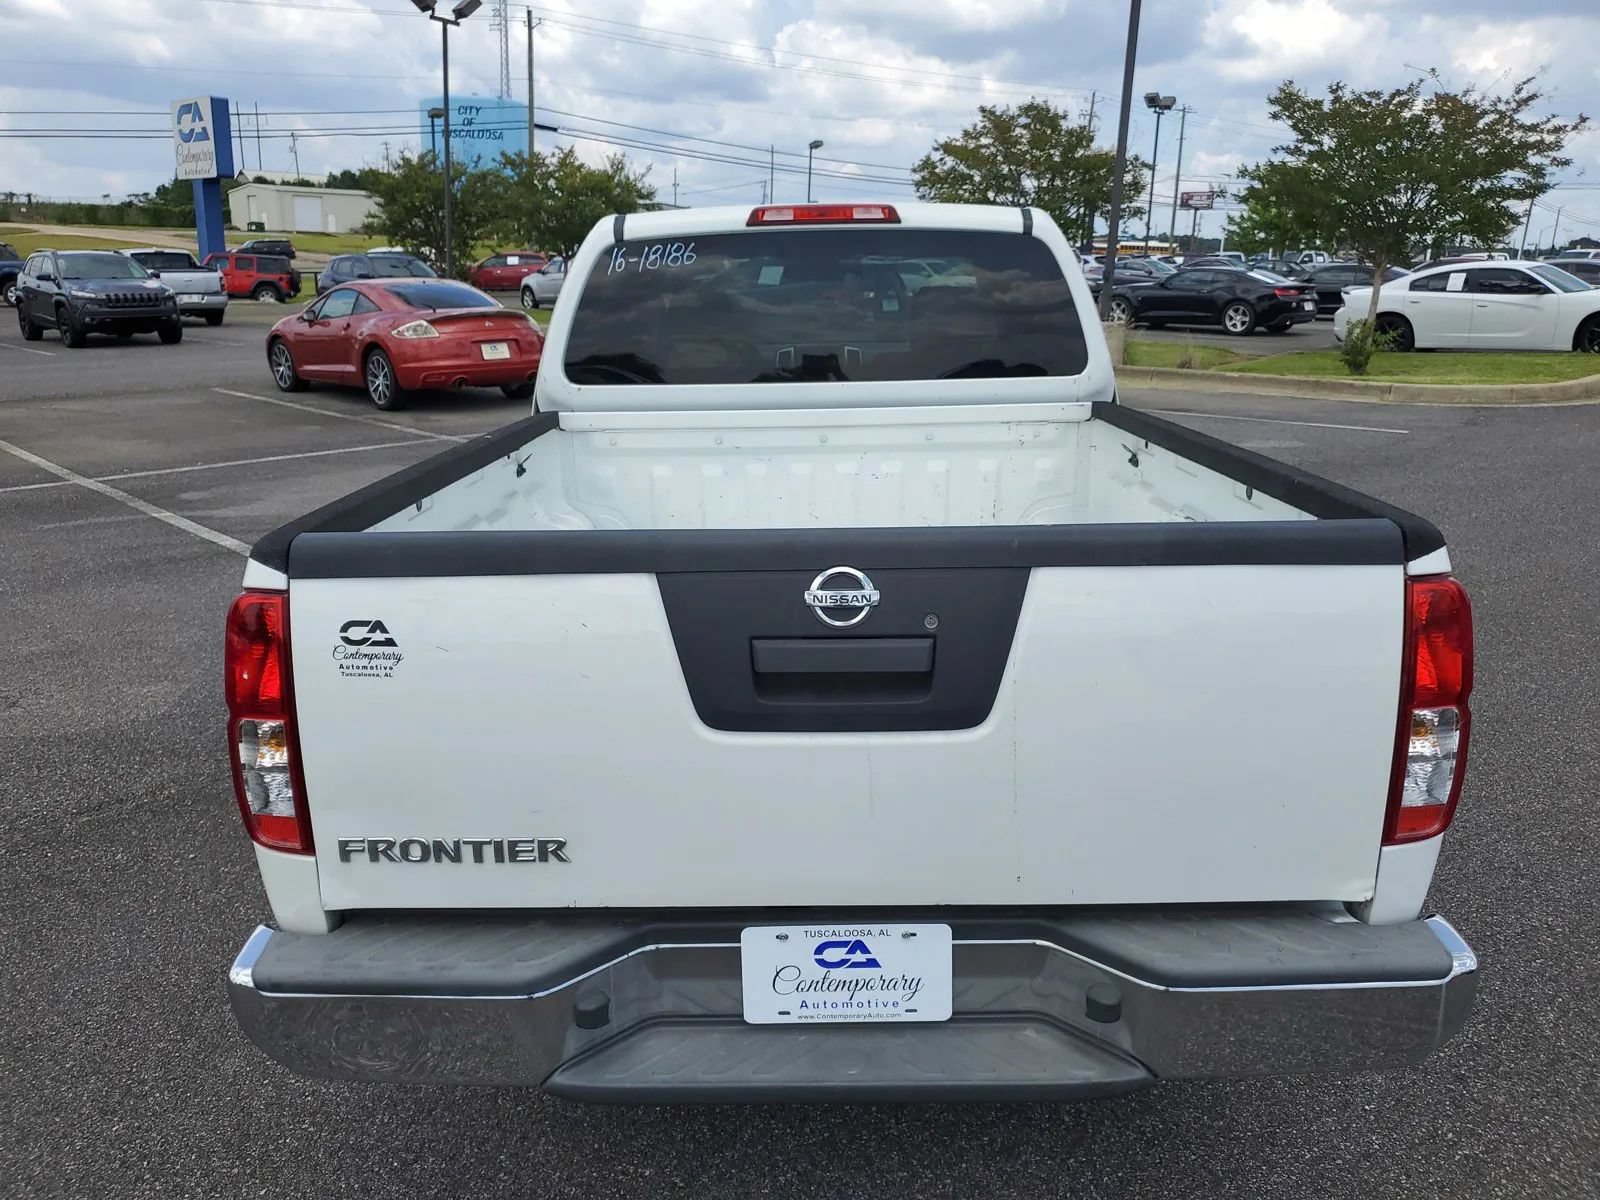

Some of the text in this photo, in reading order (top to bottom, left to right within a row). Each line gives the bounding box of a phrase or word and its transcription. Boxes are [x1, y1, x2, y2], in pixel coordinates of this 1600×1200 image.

[458, 105, 481, 116] CITY
[177, 101, 210, 143] CA
[463, 117, 475, 127] OF
[608, 242, 697, 275] 16-18186
[812, 594, 872, 604] NISSAN
[339, 620, 399, 647] CA
[332, 645, 404, 666] Contemporary
[337, 836, 572, 863] FRONTIER
[804, 929, 892, 938] TUSCALOOSA, AL
[813, 939, 882, 969] CA
[772, 965, 925, 1002] Contemporary
[799, 999, 900, 1010] Automotive
[797, 1012, 902, 1021] www.ContemporaryAuto.com
